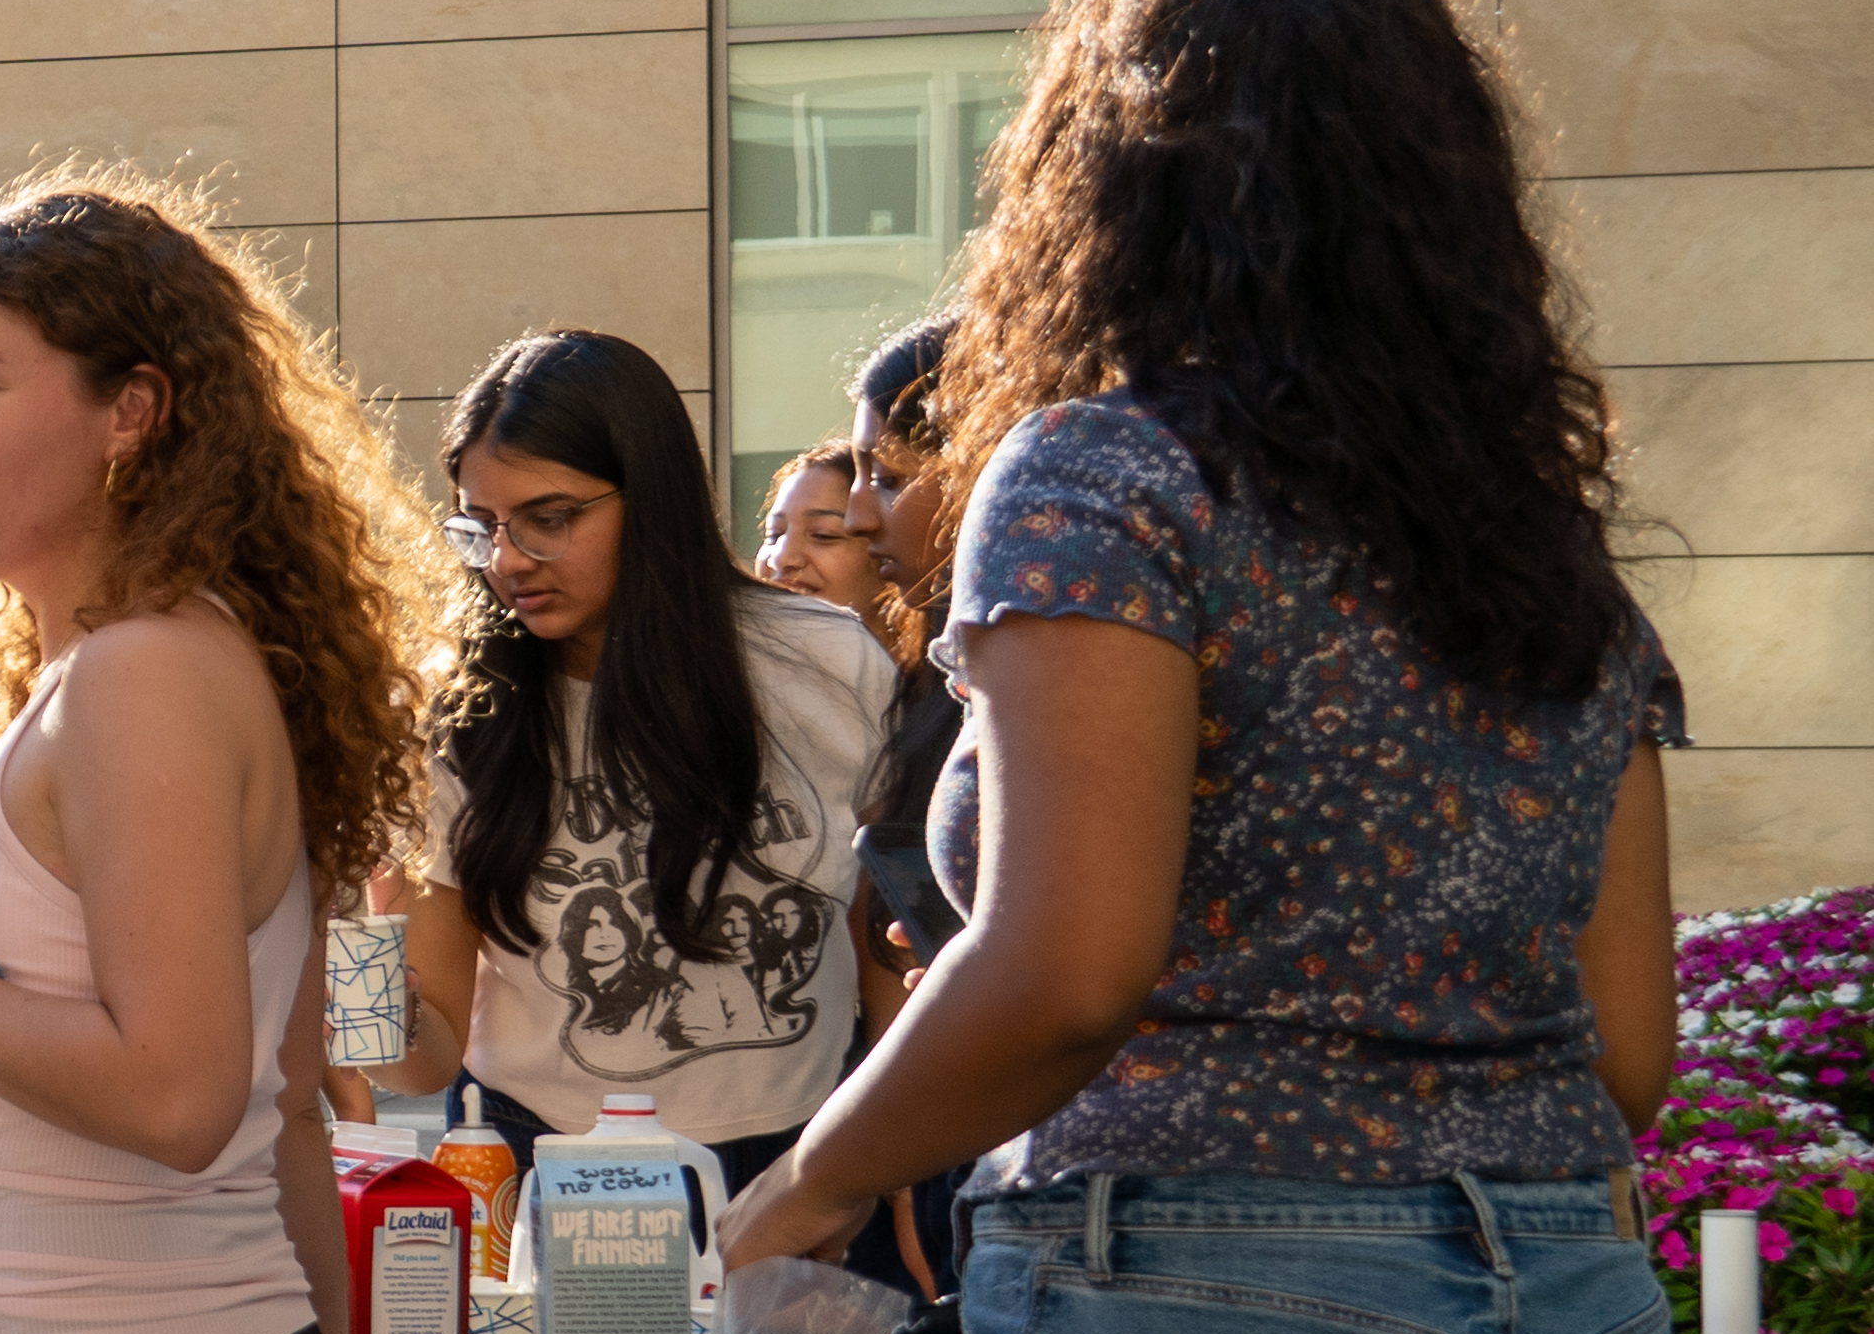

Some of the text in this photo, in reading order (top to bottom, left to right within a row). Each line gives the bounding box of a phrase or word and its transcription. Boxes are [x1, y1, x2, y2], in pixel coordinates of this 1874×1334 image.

[555, 1172, 671, 1195] no cow!
[571, 1166, 640, 1179] wow
[388, 1211, 448, 1231] Lactaid
[551, 1207, 683, 1238] WE ARE NOT
[571, 1236, 667, 1267] FINNISH!
